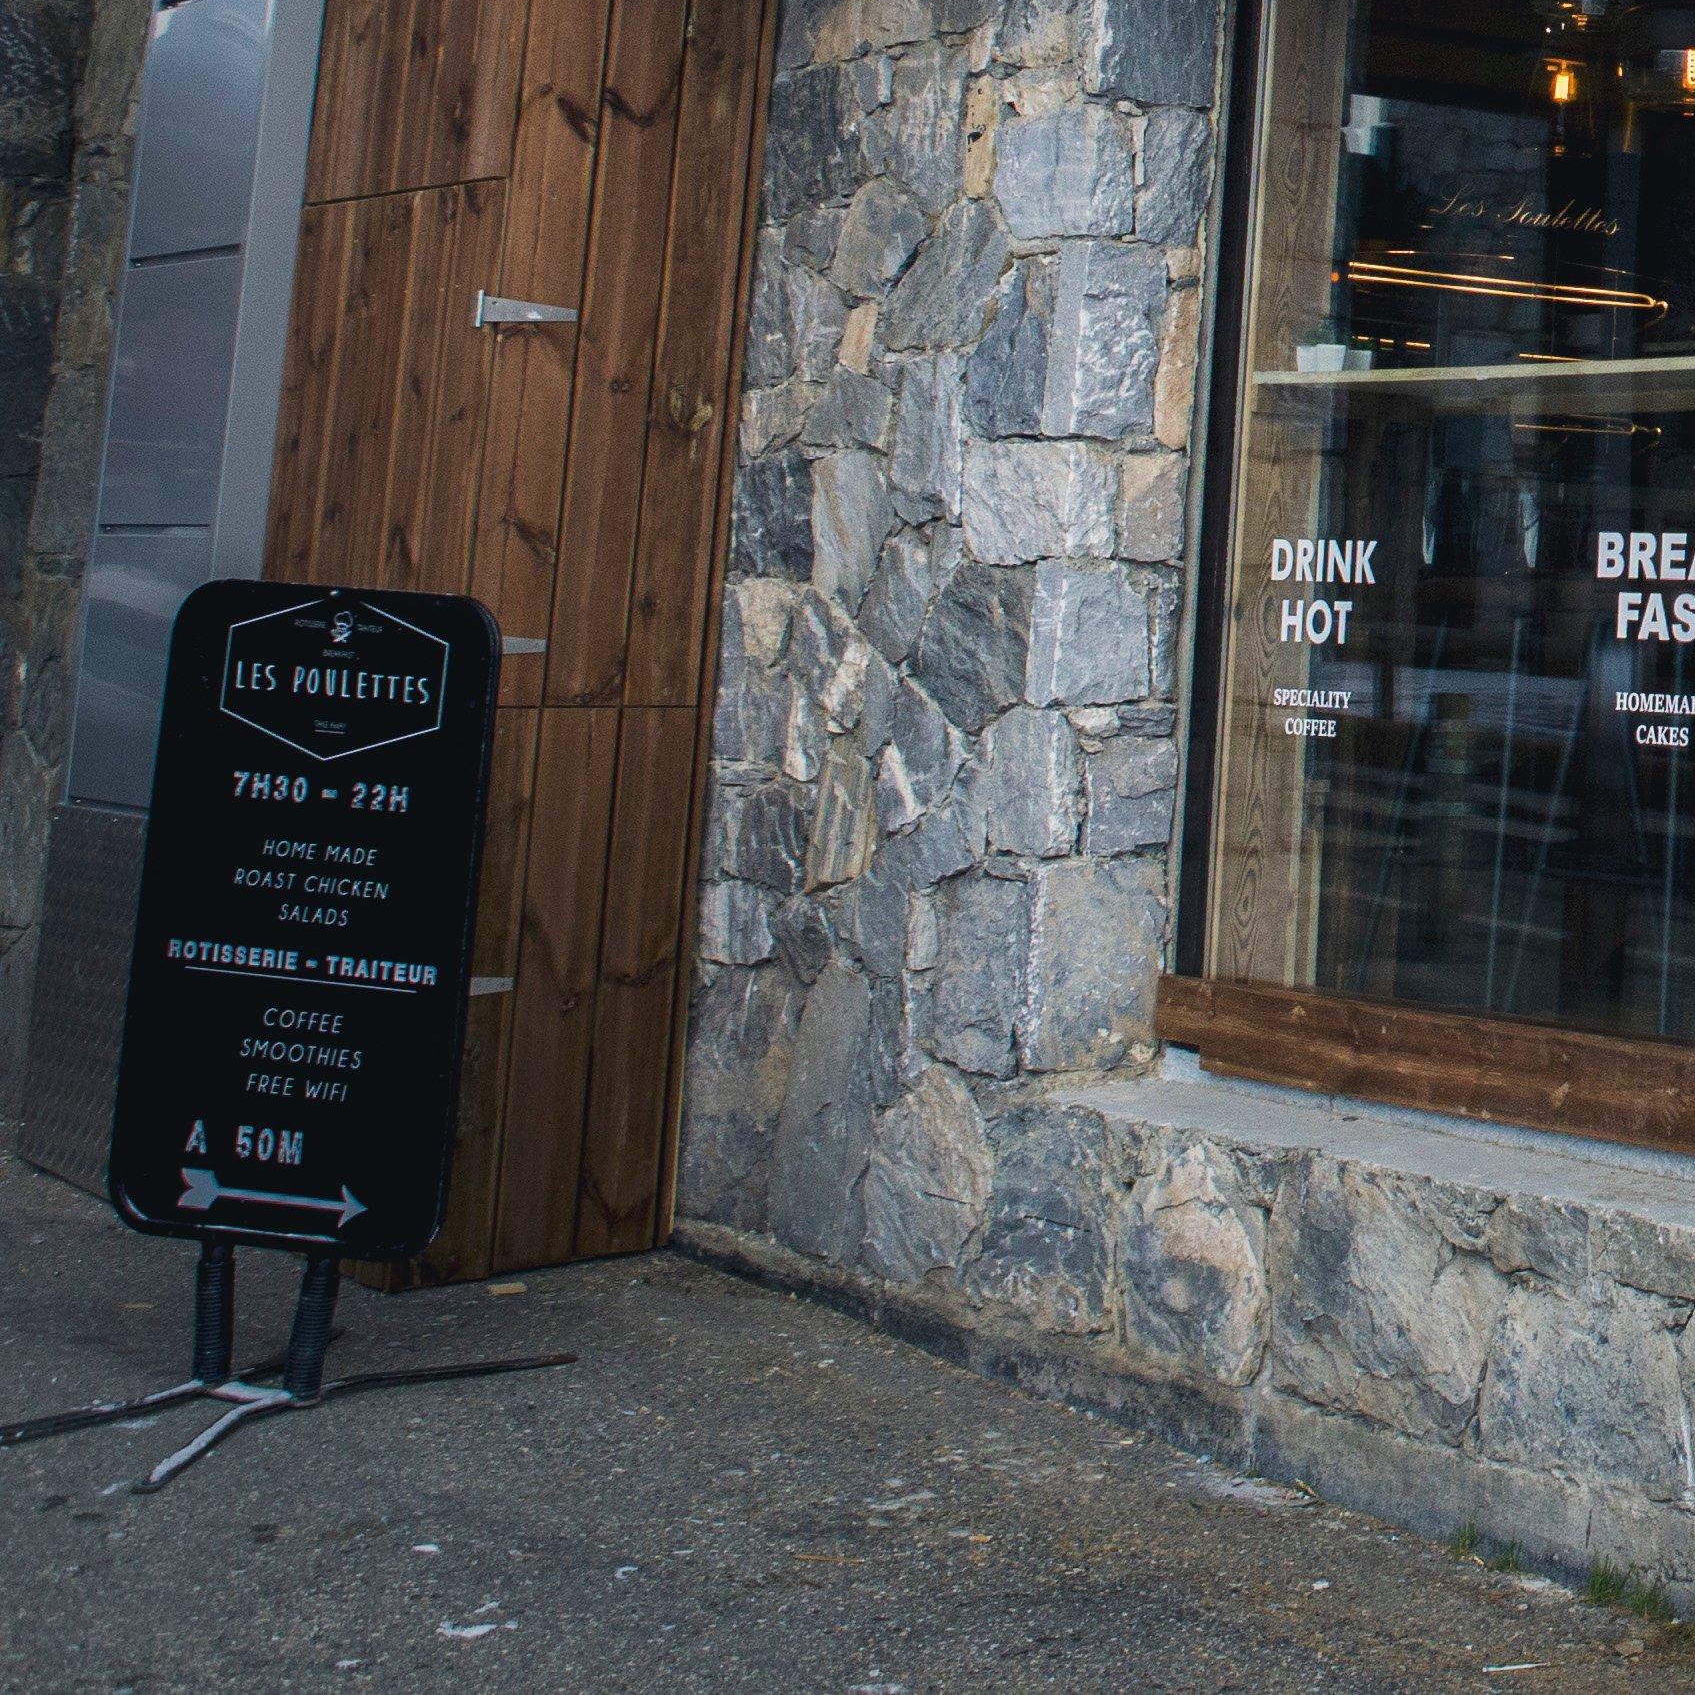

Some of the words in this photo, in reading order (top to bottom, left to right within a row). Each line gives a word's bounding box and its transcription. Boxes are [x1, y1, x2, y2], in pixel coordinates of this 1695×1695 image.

[1270, 538, 1377, 586] DRINK
[1279, 598, 1353, 646] HOT
[235, 660, 278, 691] LES
[292, 665, 430, 705] POULETTES
[1273, 687, 1351, 711] SPECIALITY
[1284, 717, 1337, 739] COFFEE
[1635, 724, 1690, 748] CAKES
[232, 770, 309, 804] 7H30
[351, 782, 410, 813] 22H
[262, 839, 318, 860] HOME
[324, 844, 379, 866] MADE
[233, 867, 297, 890] ROAST
[304, 875, 391, 900] CHICKEN
[278, 903, 350, 927] SALADS
[166, 938, 299, 970] ROTISSERIE
[325, 954, 438, 985] TRAITEUR
[262, 1007, 344, 1034] COFFEE
[239, 1038, 364, 1070] SMOOTHIES
[246, 1073, 295, 1096] FREE
[305, 1080, 350, 1103] WIFI
[184, 1118, 207, 1154] A
[234, 1123, 305, 1166] 50M
